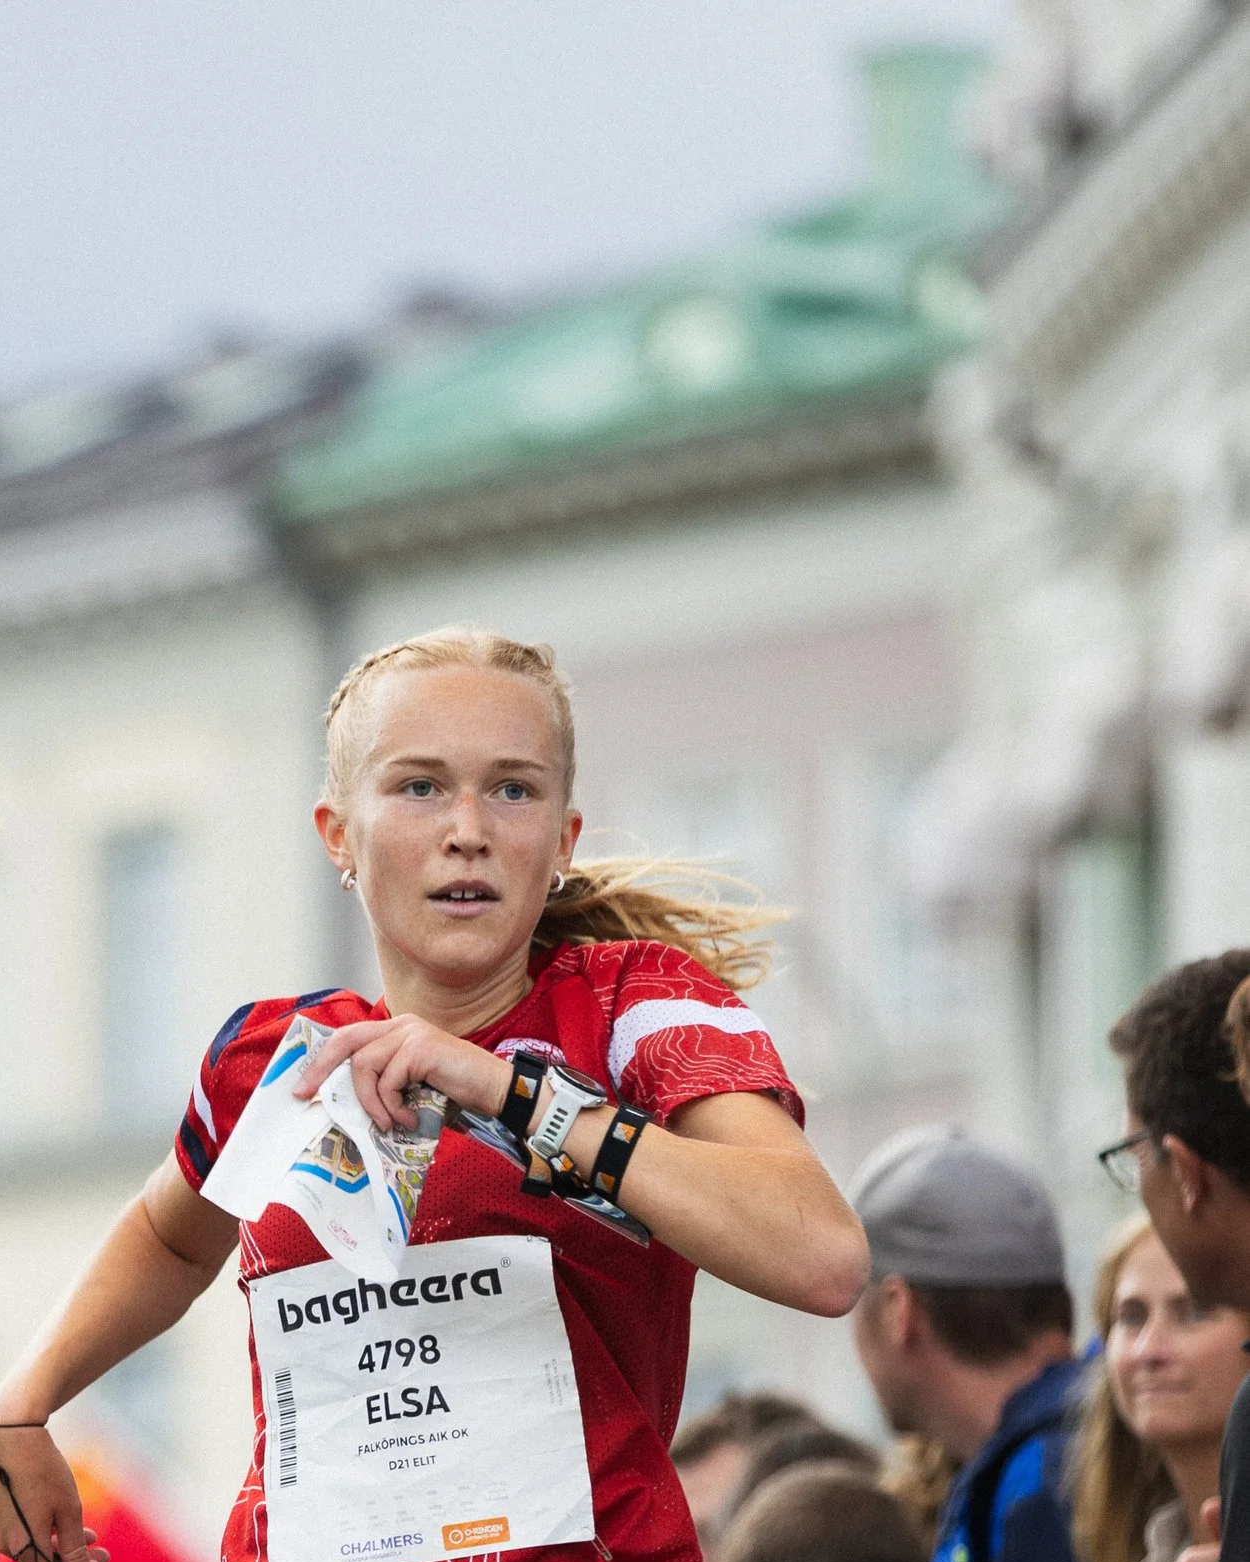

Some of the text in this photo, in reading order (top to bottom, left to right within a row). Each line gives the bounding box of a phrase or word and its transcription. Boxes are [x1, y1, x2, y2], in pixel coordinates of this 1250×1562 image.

[358, 1334, 441, 1373] 4798
[366, 1385, 451, 1425] ELSA
[357, 1427, 469, 1456] FALKÖPINGS AIK OK
[388, 1455, 436, 1471] D21 ELIT
[340, 1532, 424, 1556] CHALMERS
